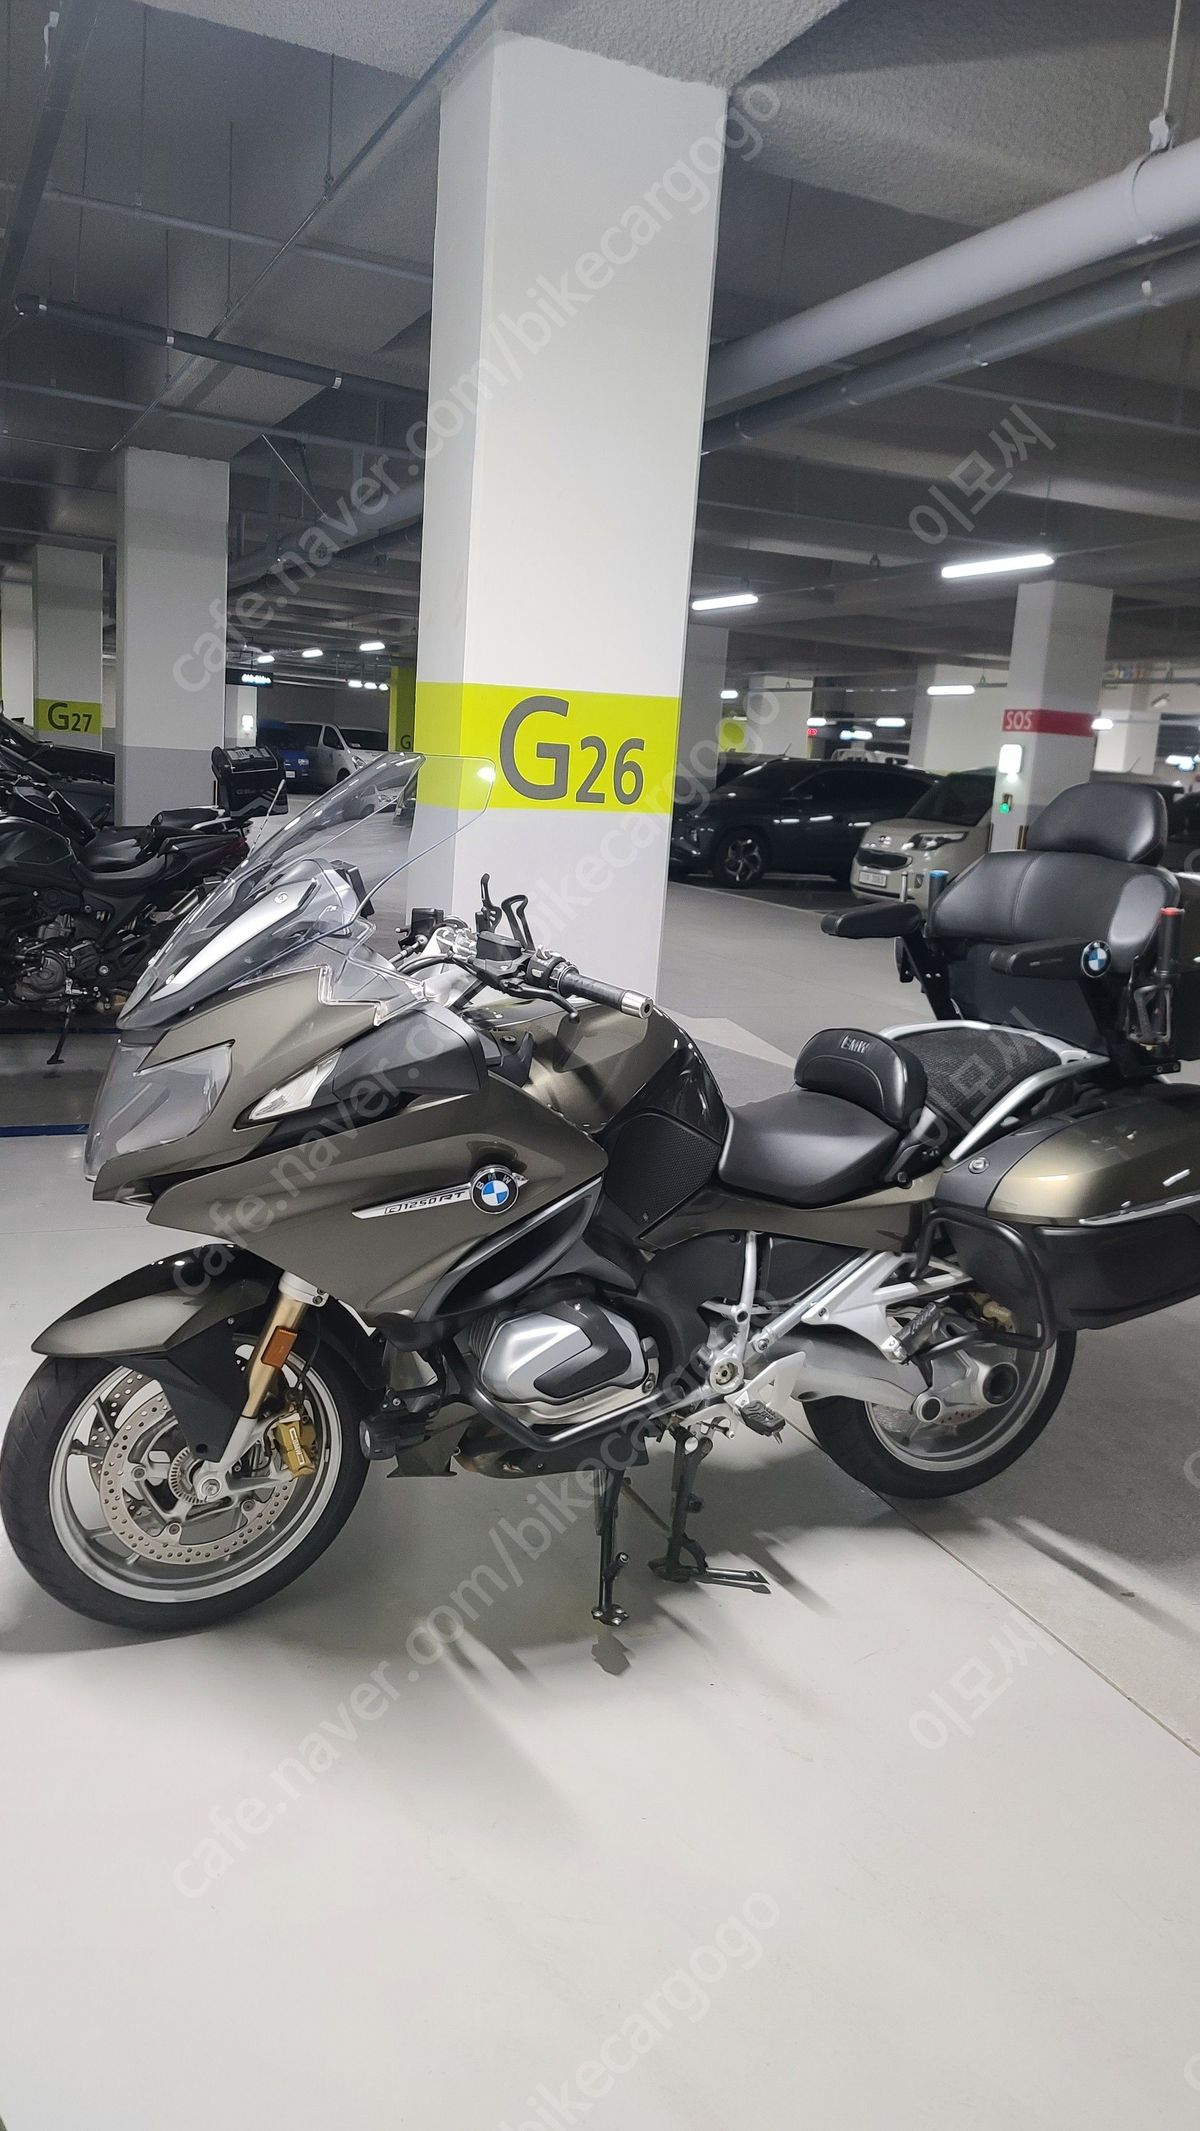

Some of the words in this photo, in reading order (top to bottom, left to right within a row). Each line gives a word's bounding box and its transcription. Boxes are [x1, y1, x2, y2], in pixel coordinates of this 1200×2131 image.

[47, 702, 93, 732] G27
[1005, 711, 1033, 730] SOS
[500, 695, 645, 805] G26
[475, 1174, 512, 1190] BMW
